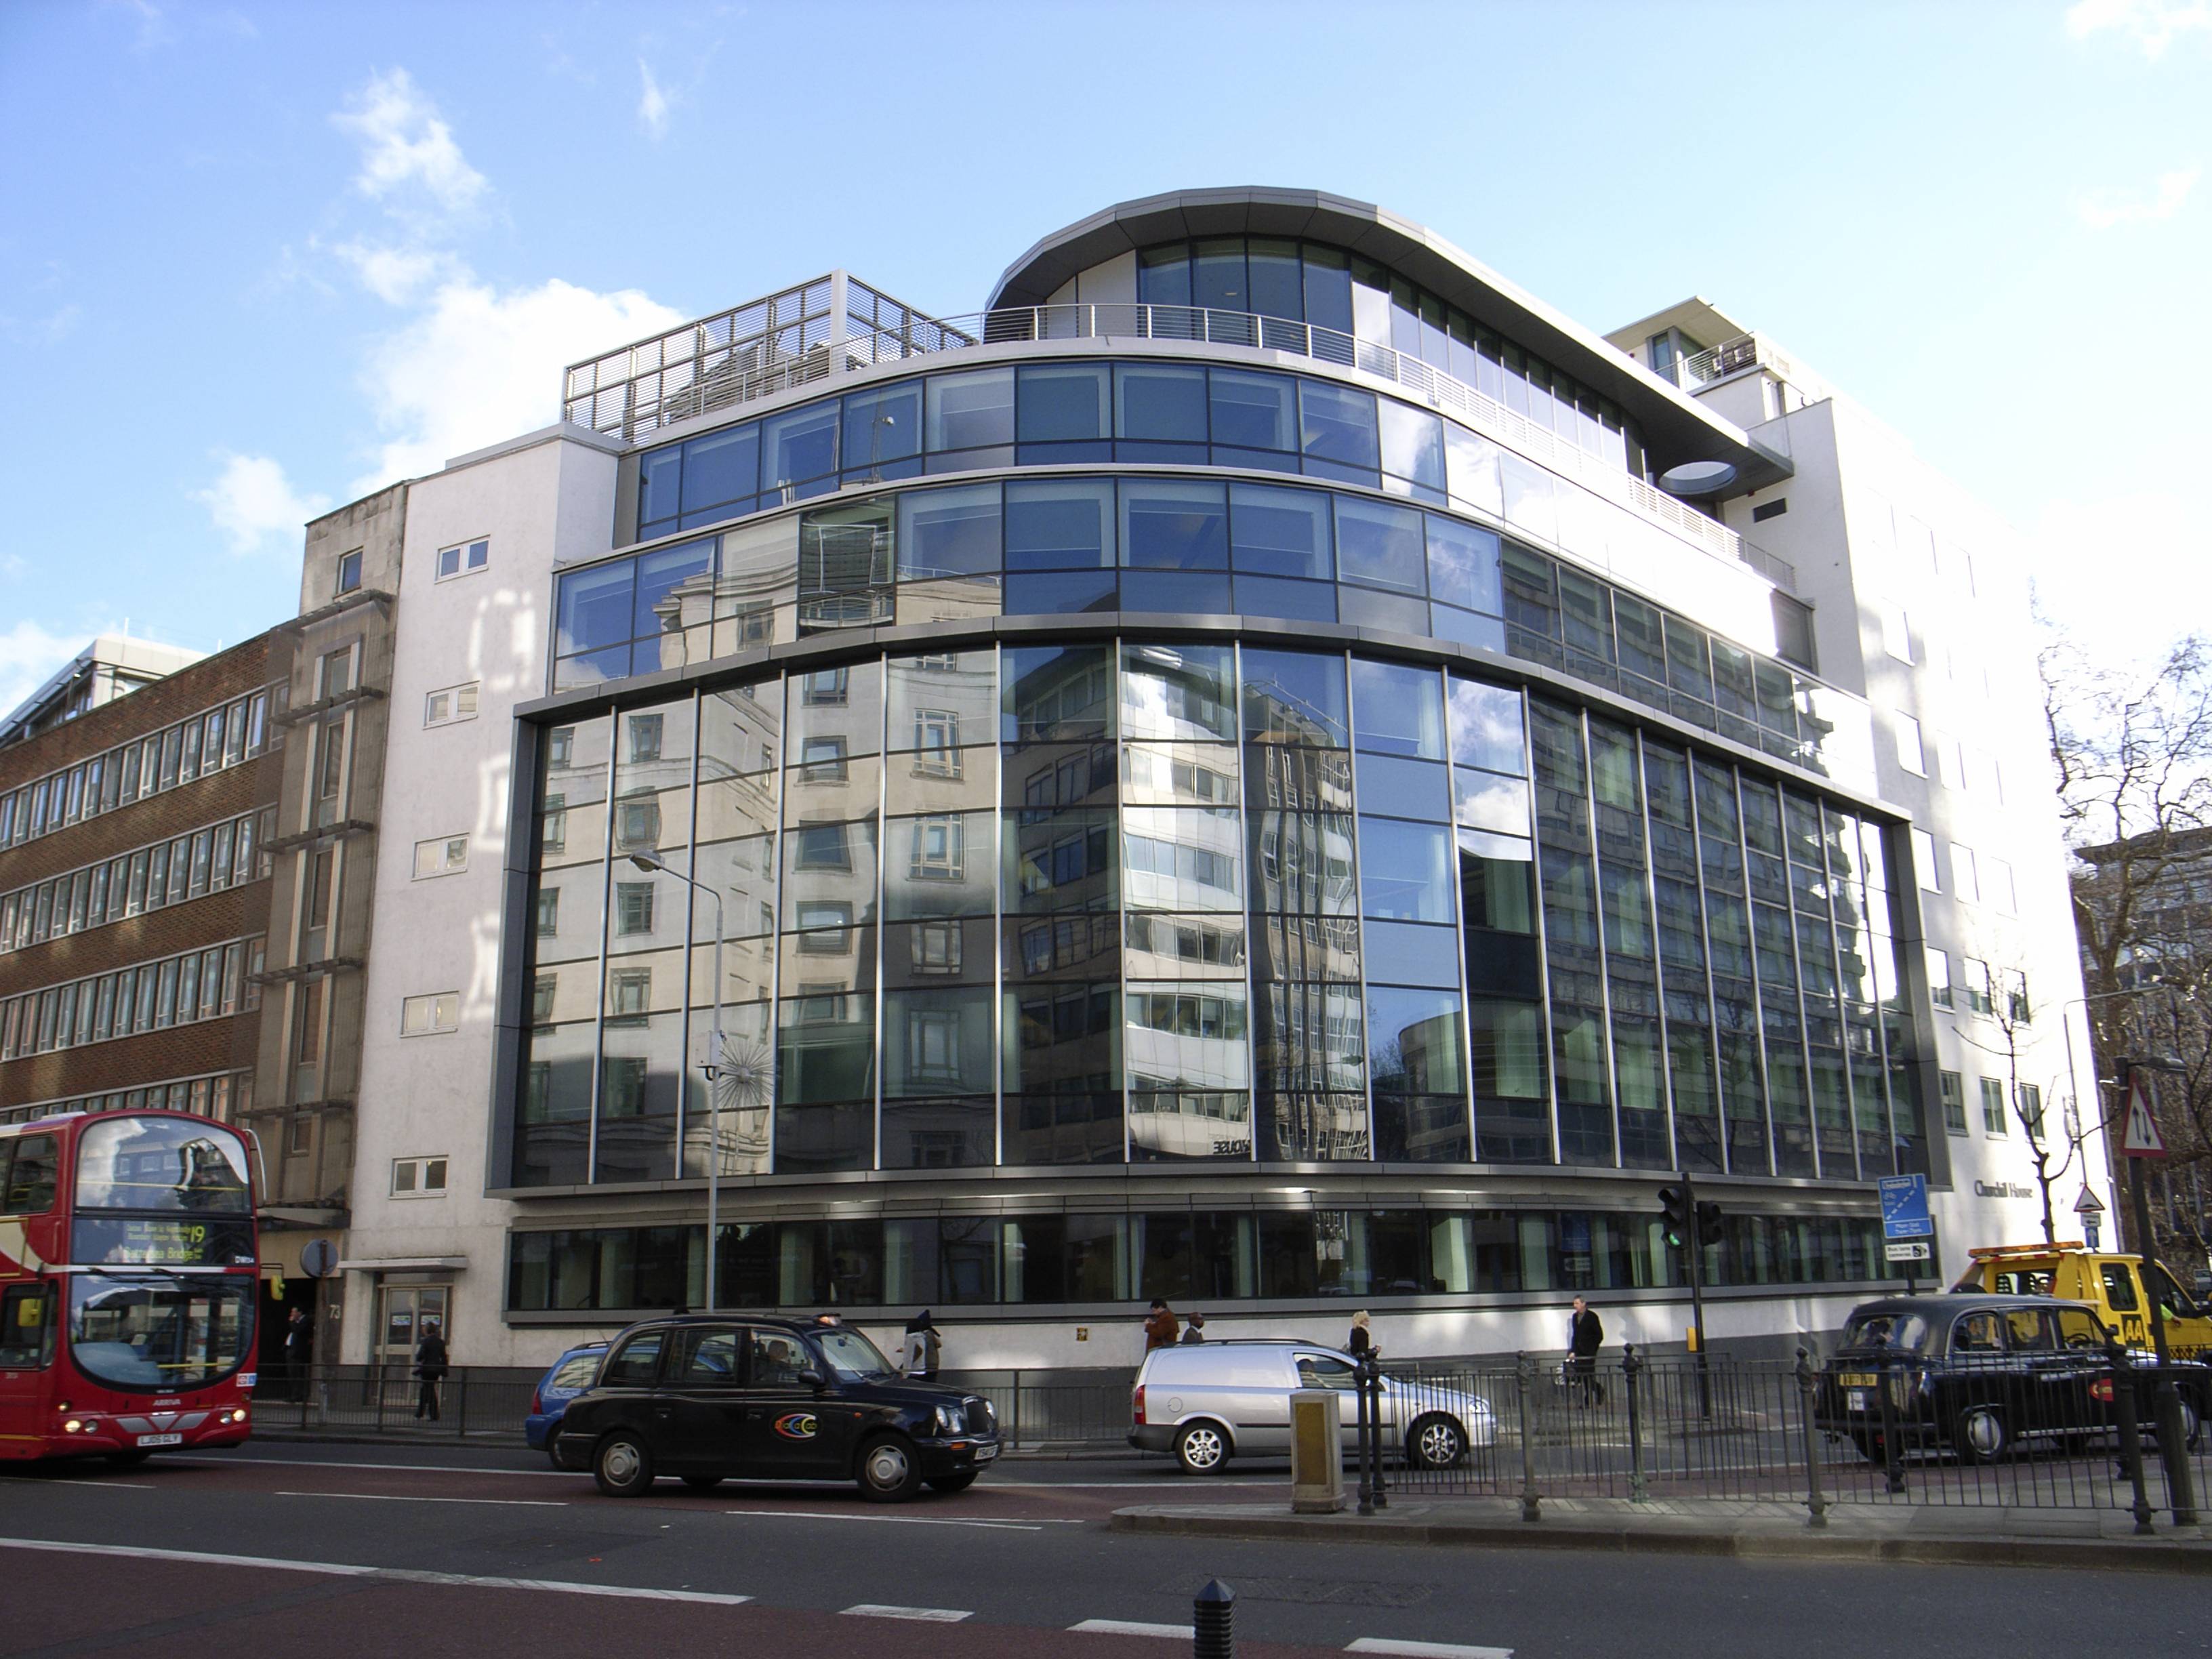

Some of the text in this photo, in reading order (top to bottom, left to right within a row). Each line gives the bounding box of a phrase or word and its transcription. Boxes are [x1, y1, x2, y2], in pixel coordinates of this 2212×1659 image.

[2009, 1183, 2032, 1198] House
[190, 1225, 205, 1242] 19
[167, 1246, 194, 1262] Bridge
[329, 1304, 341, 1319] 73
[2125, 1319, 2144, 1340] AA
